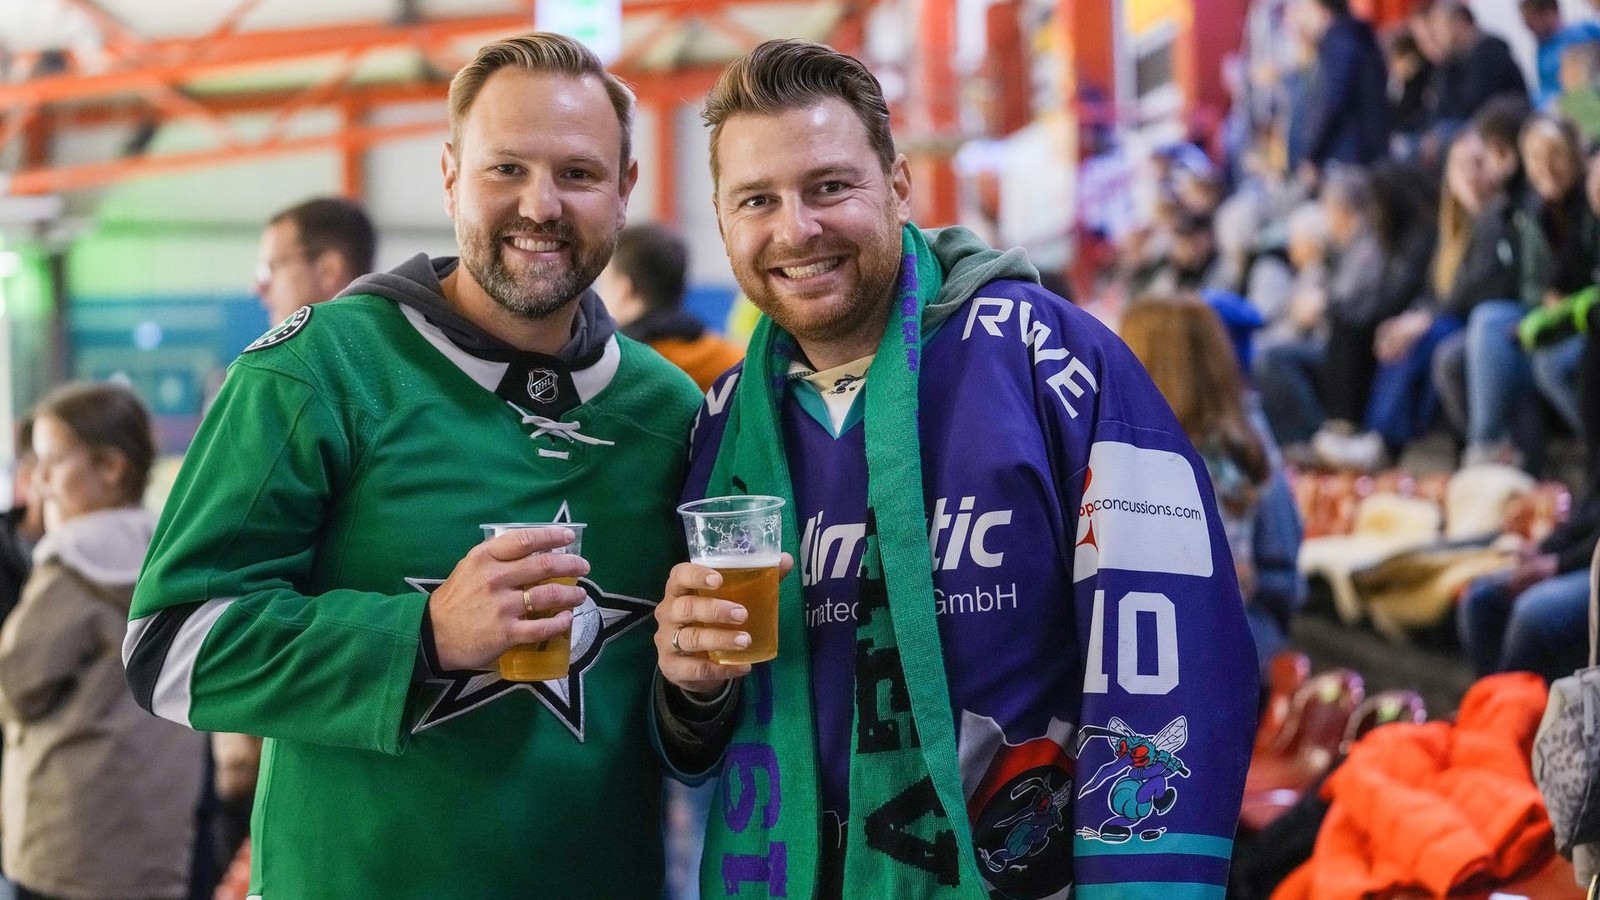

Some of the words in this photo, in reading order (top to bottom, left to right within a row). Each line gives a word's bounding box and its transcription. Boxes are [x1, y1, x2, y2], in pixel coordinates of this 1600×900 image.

[534, 377, 553, 394] NHL
[962, 297, 1100, 419] RWE
[1079, 499, 1202, 521] opconcussions.com
[1083, 589, 1180, 695] 10
